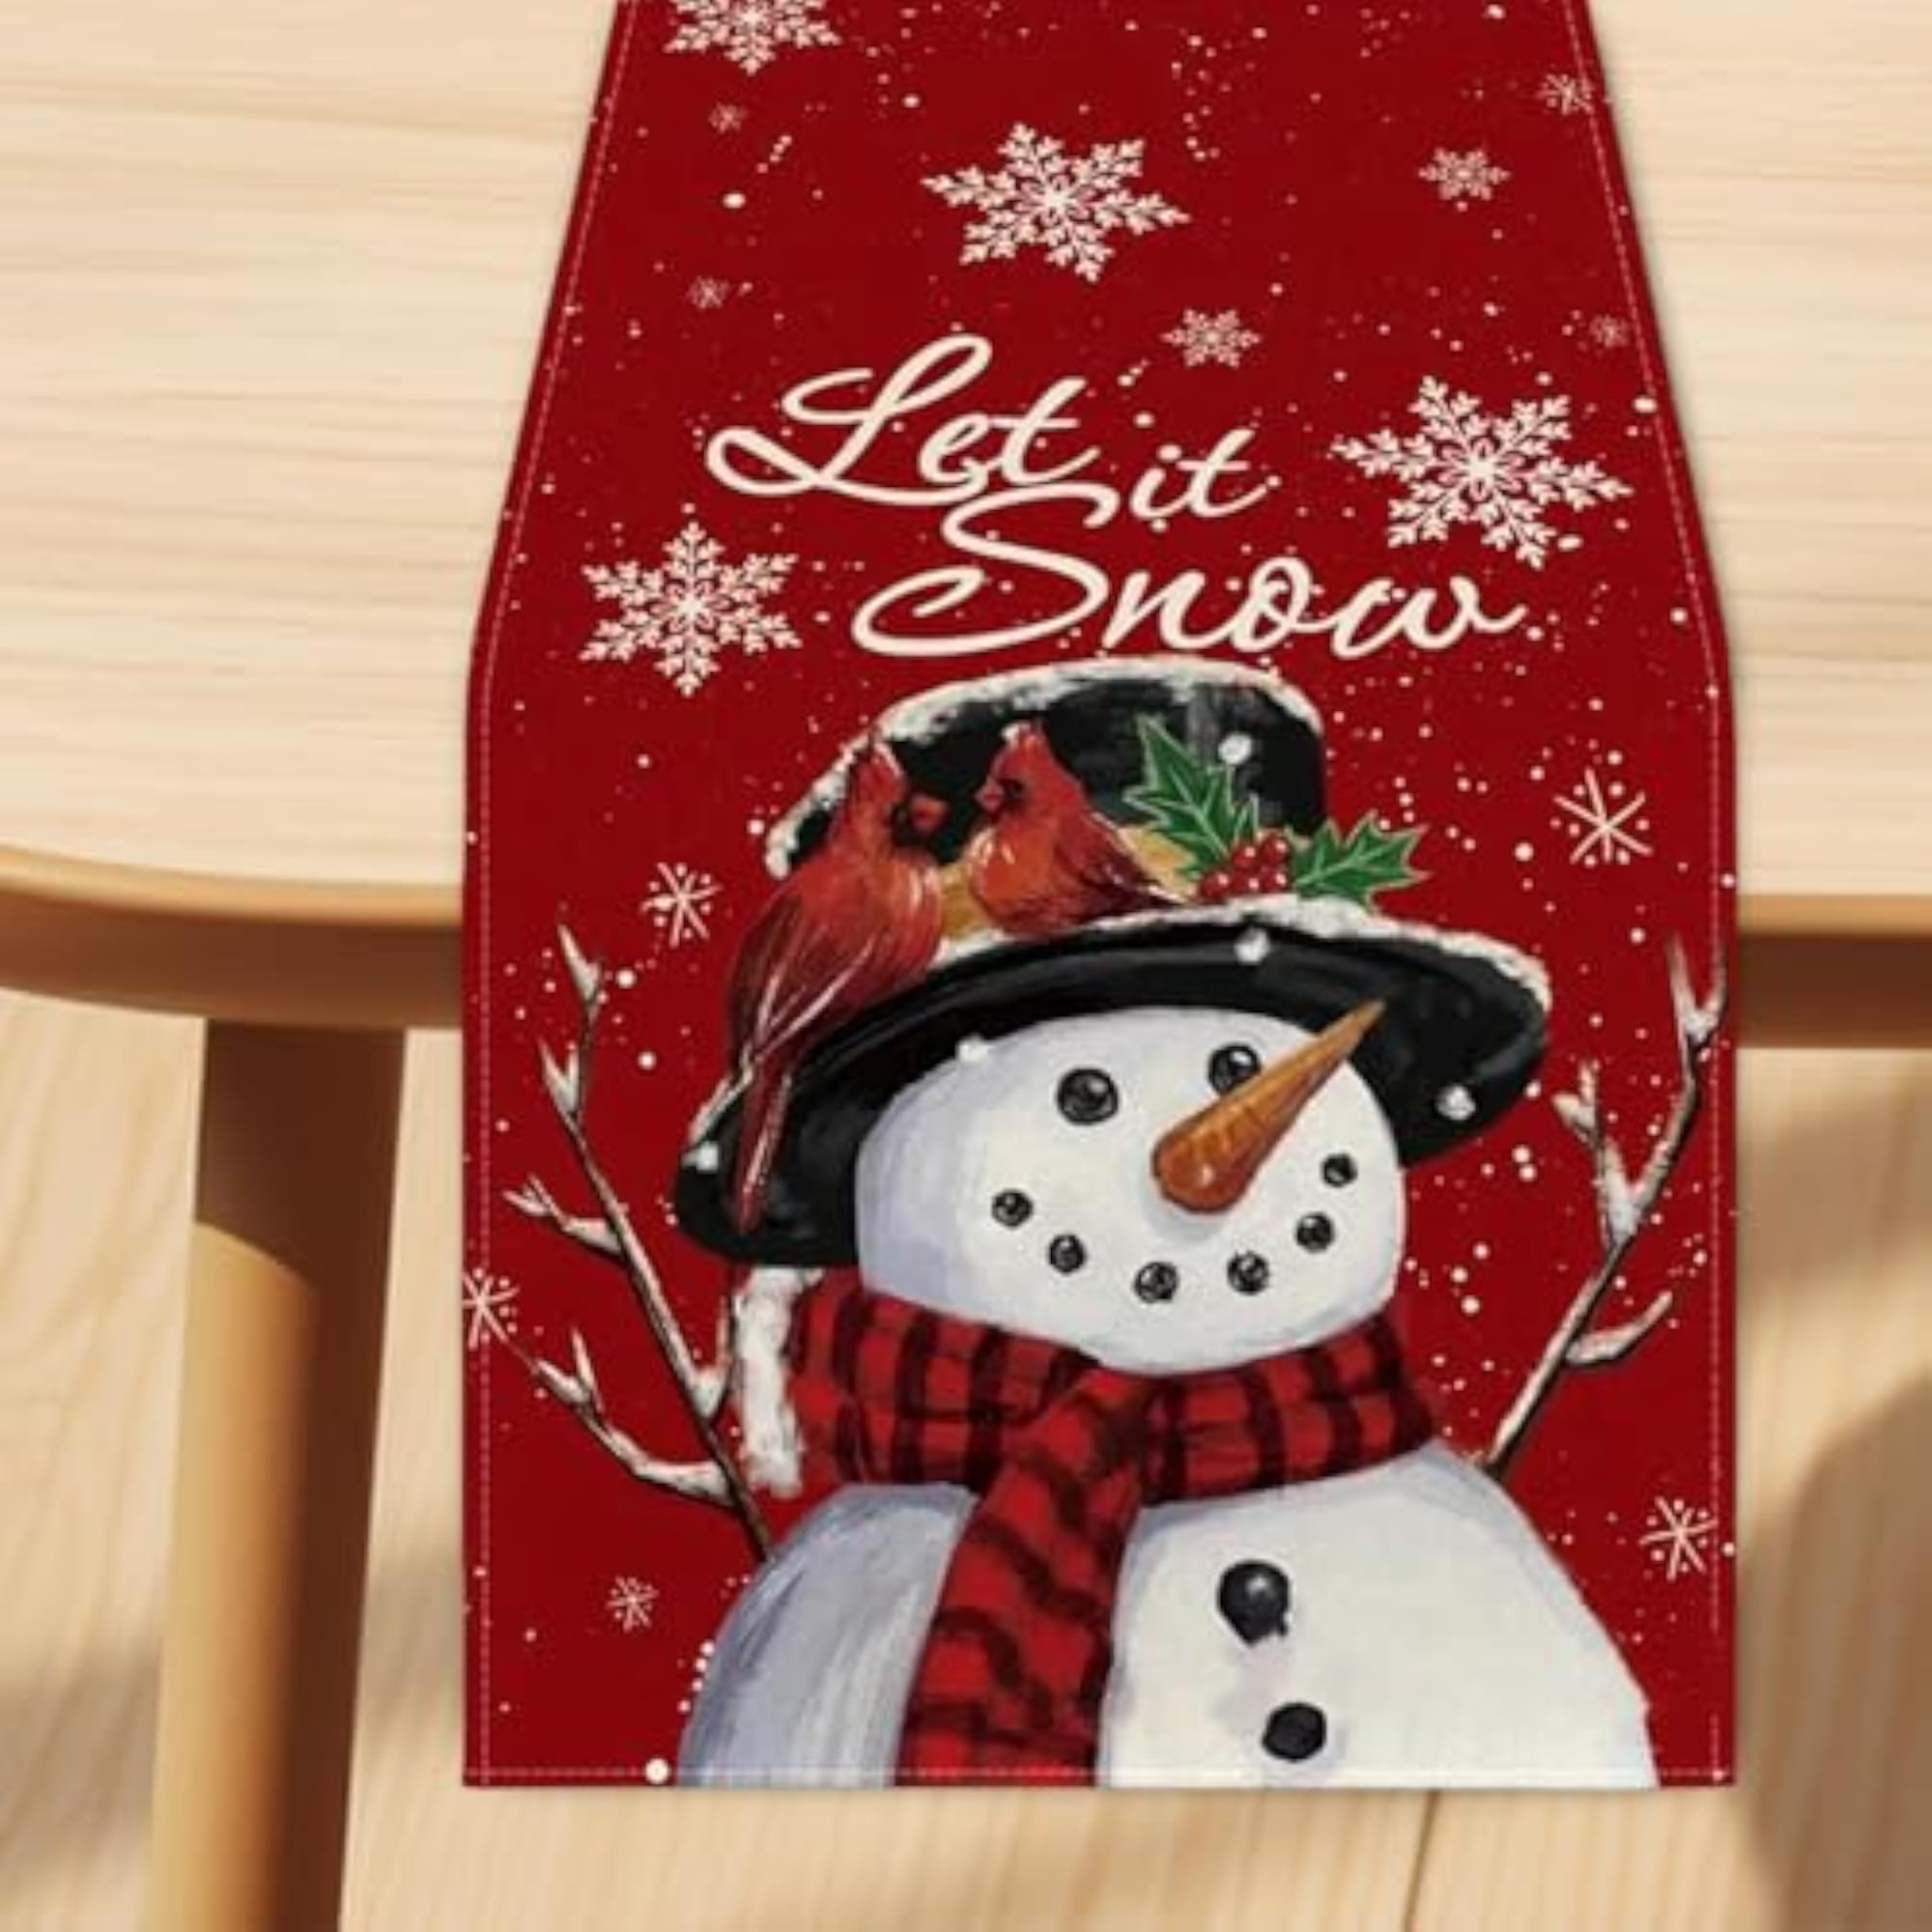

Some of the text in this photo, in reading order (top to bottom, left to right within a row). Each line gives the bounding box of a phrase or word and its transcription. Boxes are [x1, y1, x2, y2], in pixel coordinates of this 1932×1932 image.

[704, 334, 1267, 520] Let it
[851, 482, 1527, 658] Snow
